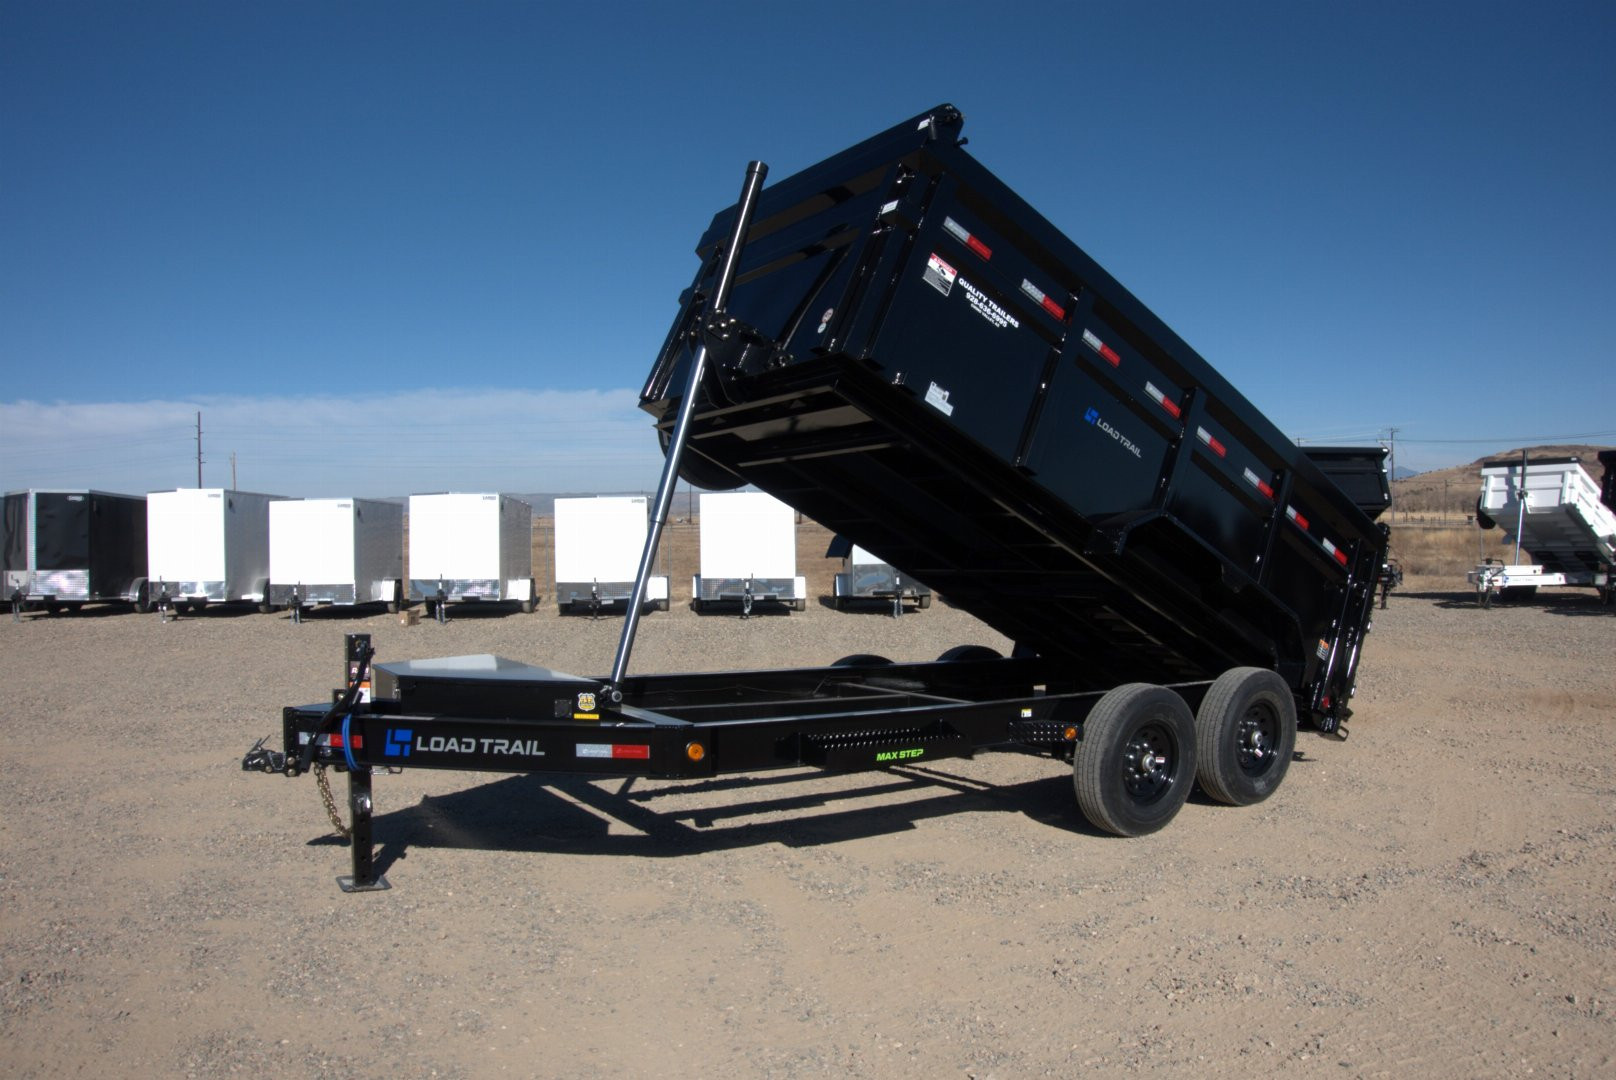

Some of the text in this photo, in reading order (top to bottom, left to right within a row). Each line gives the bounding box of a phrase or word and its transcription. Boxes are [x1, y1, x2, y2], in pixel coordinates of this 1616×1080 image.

[958, 277, 988, 302] QUALITY
[989, 301, 1020, 328] TRAILERS
[1097, 418, 1142, 458] LOAD TRAIL
[416, 736, 545, 756] LOAD TRAIL
[876, 749, 924, 760] MAX STEP
